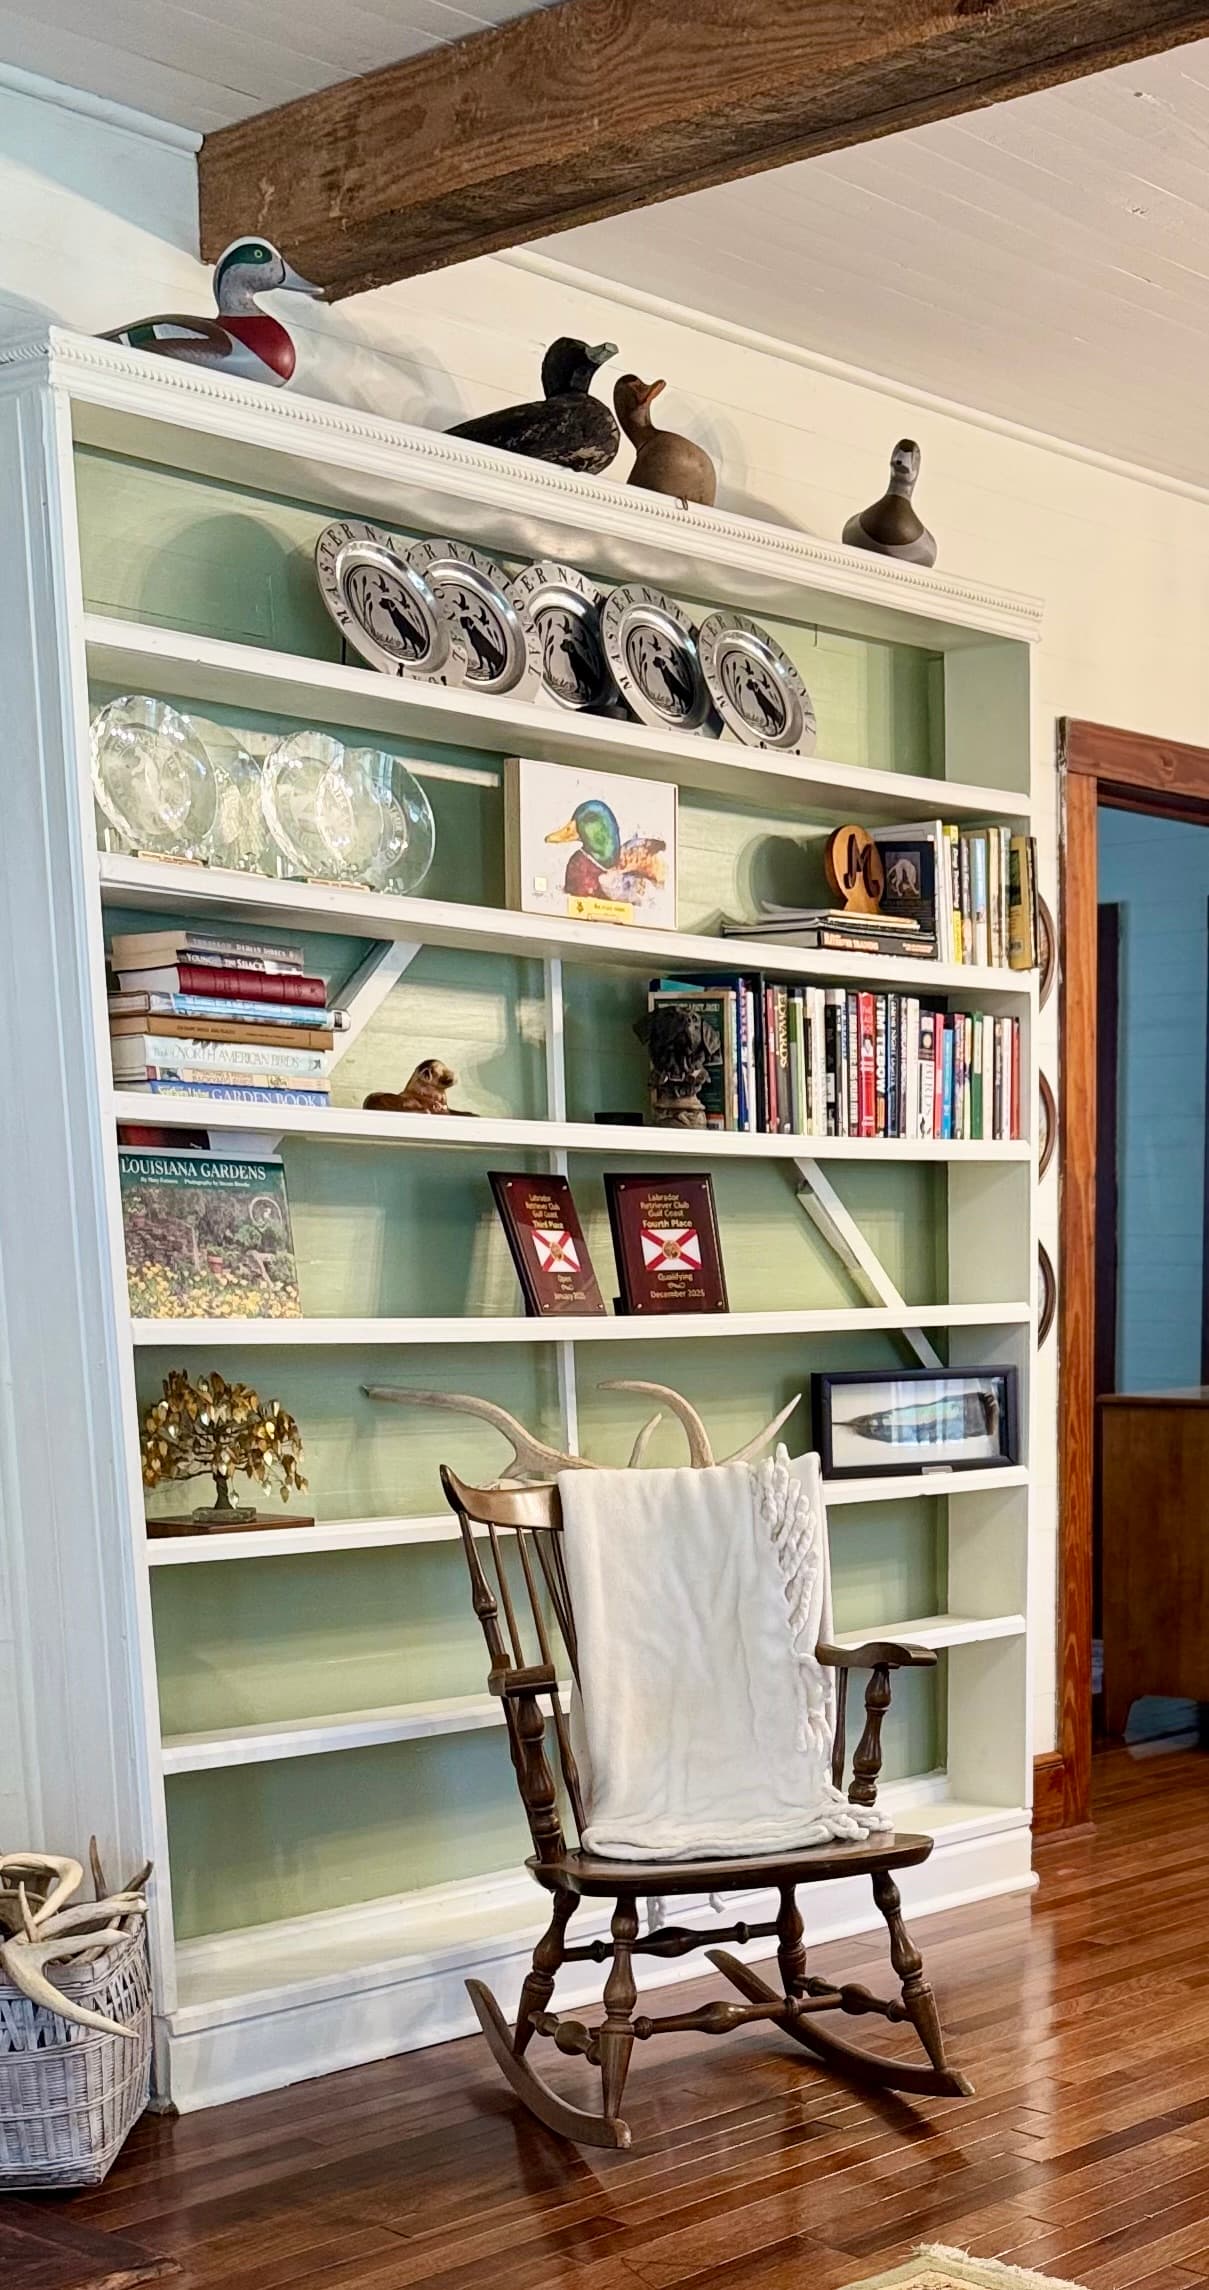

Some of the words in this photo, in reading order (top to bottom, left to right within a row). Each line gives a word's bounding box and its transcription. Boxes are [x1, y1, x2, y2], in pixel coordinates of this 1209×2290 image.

[843, 833, 881, 897] M
[876, 1000, 886, 1029] TIM
[777, 992, 788, 1068] EDWARDS
[175, 1044, 216, 1063] NORTH
[218, 1048, 270, 1066] AMERICAN
[271, 1052, 300, 1070] BIRDS
[876, 1036, 886, 1093] TEBOW
[211, 1088, 273, 1104] GARDEN
[274, 1092, 317, 1107] BOOK
[925, 1063, 933, 1117] BIRDS
[120, 1158, 198, 1177] LOUISIANA
[200, 1163, 267, 1181] GARDENS
[639, 1201, 672, 1210] Retriever
[672, 1201, 690, 1210] Club
[647, 1193, 680, 1202] Labrador
[642, 1219, 670, 1229] Fourth
[670, 1219, 693, 1228] Place
[650, 1289, 687, 1299] December
